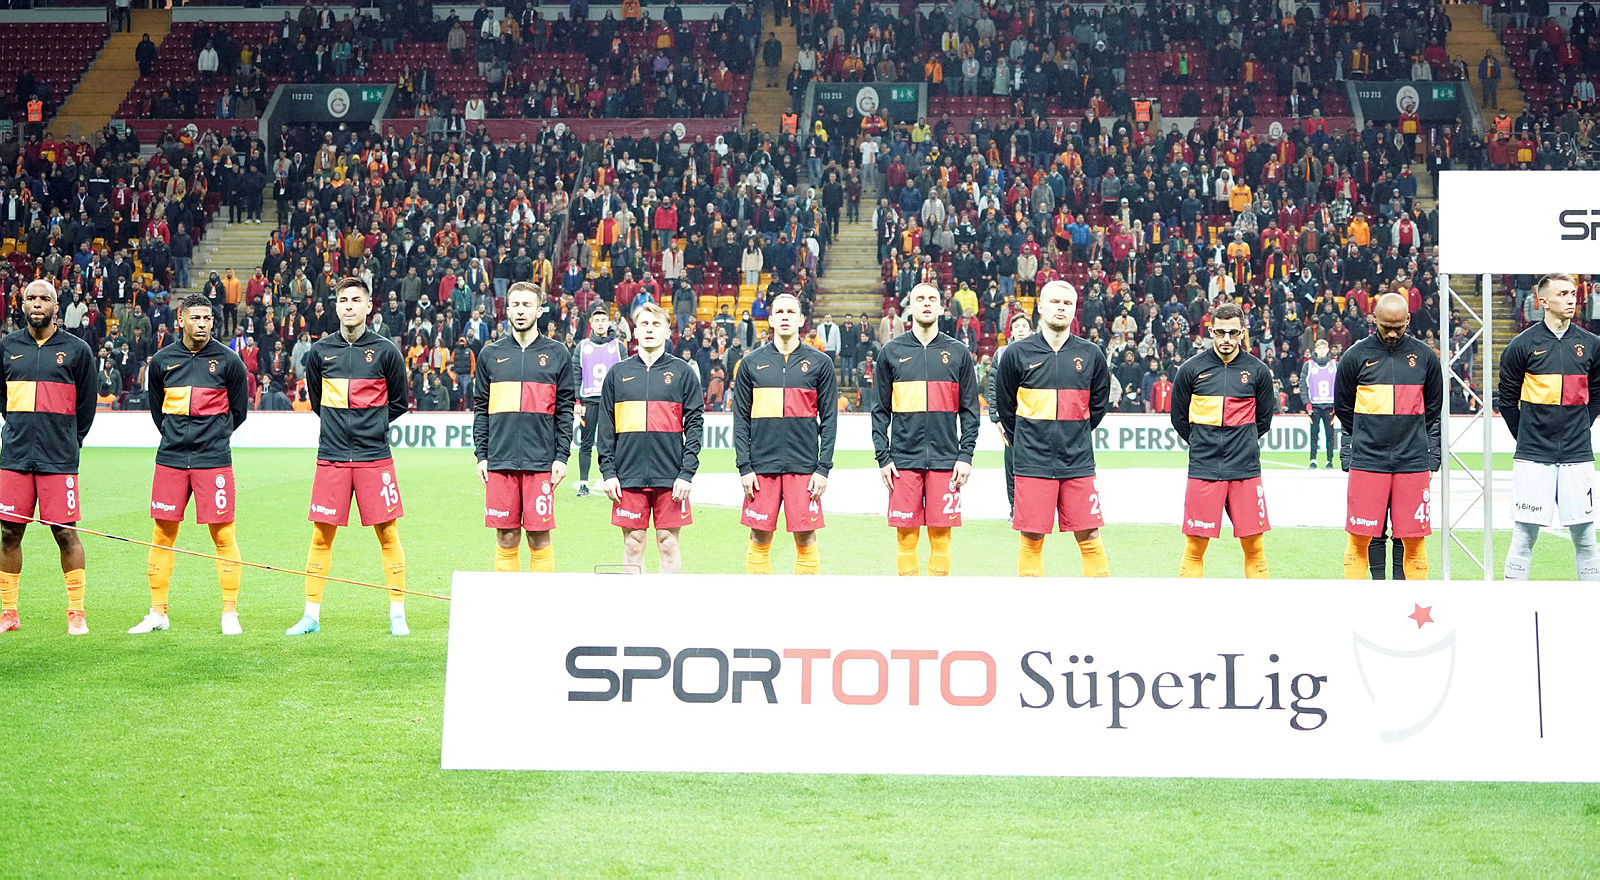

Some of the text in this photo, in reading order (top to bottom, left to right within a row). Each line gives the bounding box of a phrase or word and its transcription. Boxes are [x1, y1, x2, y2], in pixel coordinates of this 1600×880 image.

[1319, 381, 1329, 397] 8
[66, 489, 76, 509] 8
[215, 489, 227, 509] 6
[380, 483, 399, 507] 15
[1586, 487, 1593, 507] 1
[1257, 498, 1265, 518] 3
[1521, 503, 1543, 512] Bitget
[566, 646, 1328, 731] SPORTOTO SüperLig
